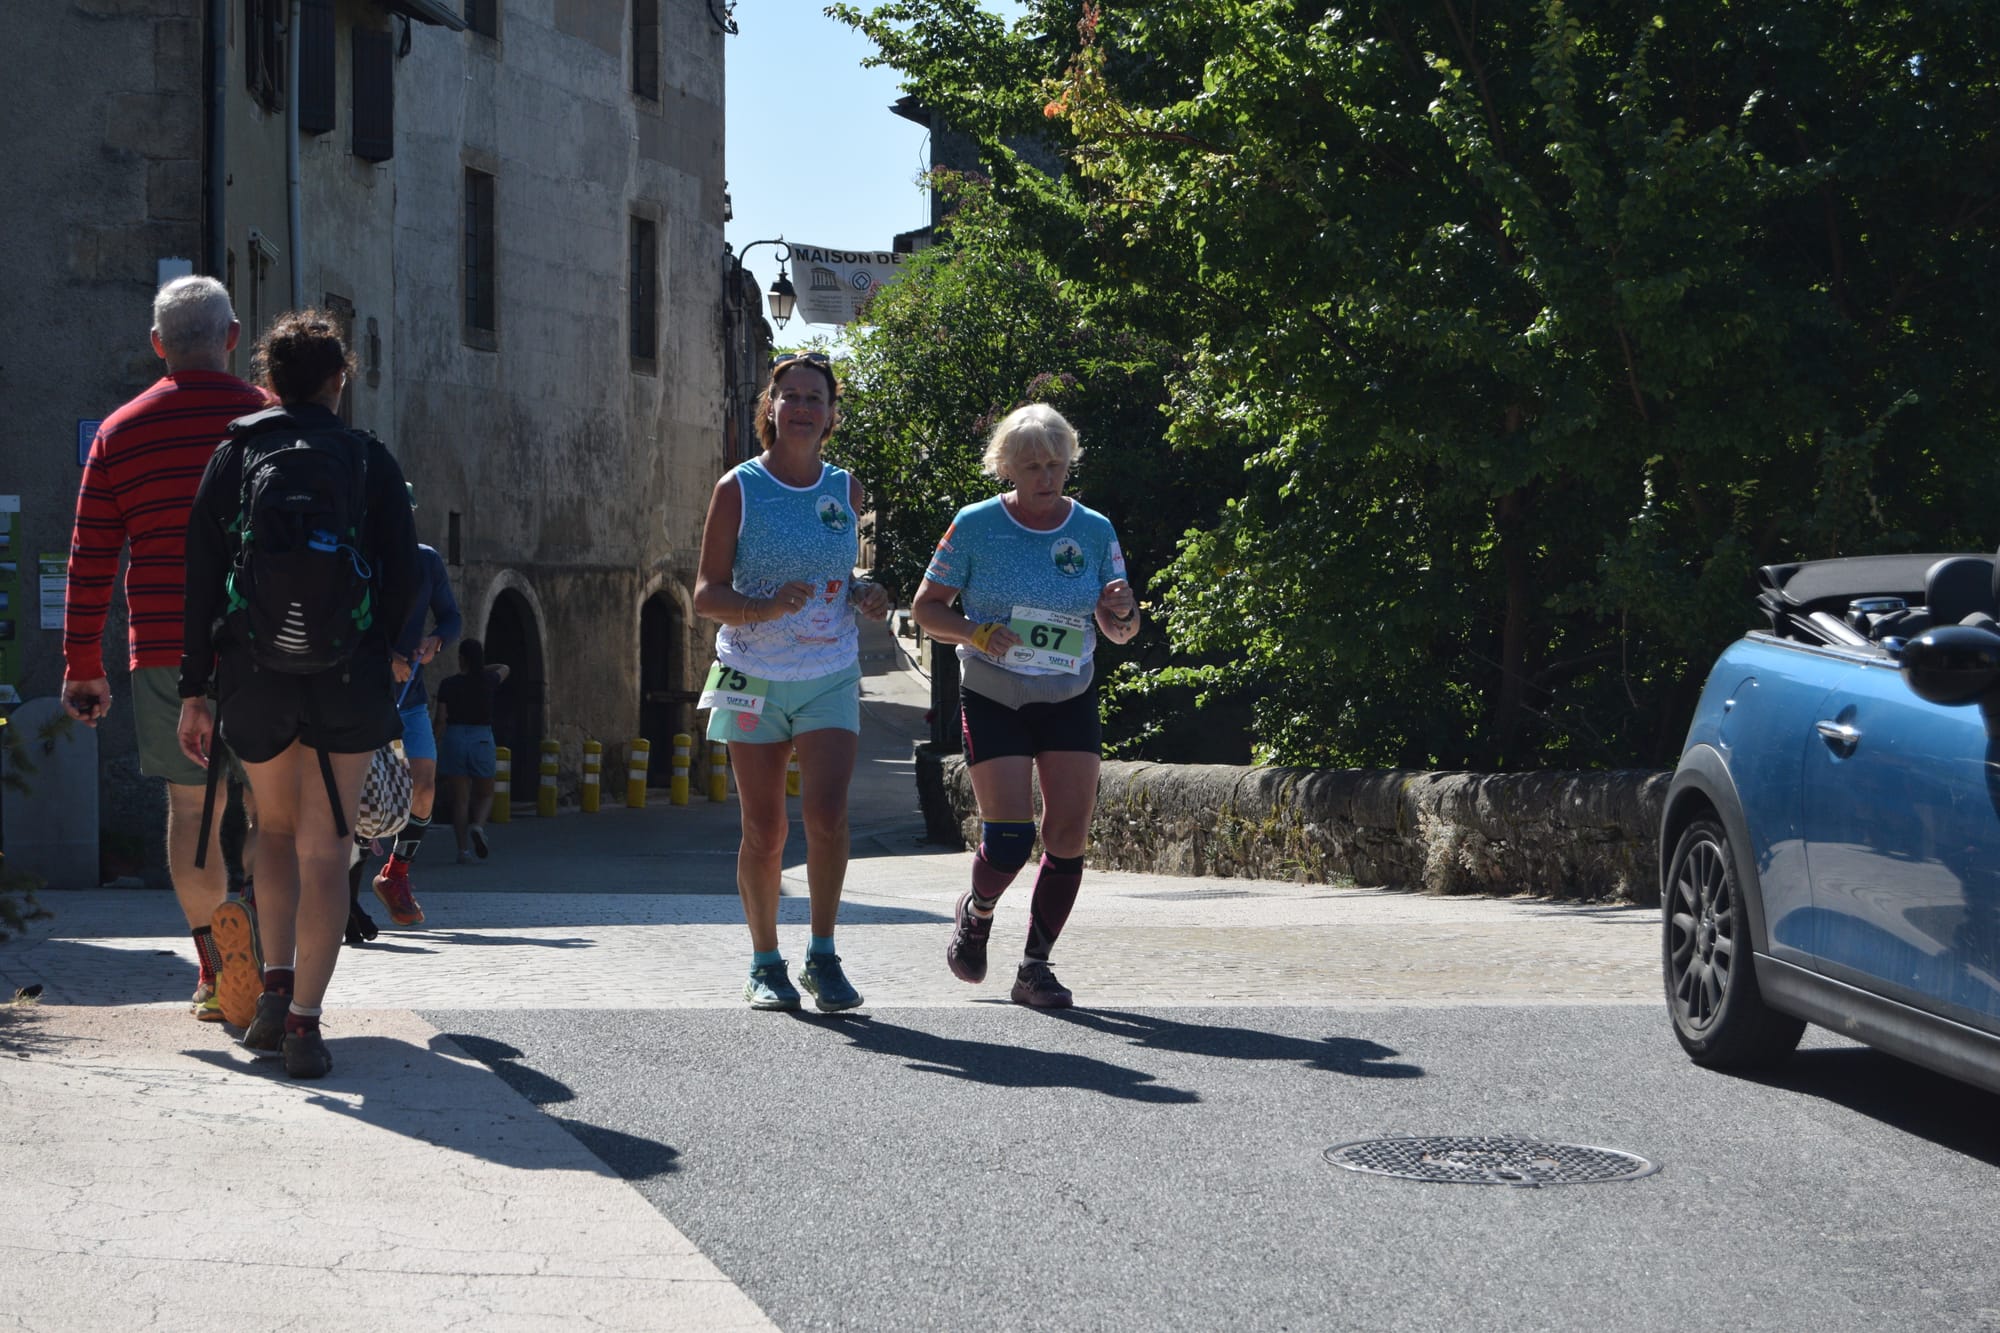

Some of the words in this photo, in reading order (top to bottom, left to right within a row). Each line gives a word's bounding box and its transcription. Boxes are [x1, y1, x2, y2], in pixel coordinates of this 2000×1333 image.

[795, 249, 872, 264] MAISON
[876, 253, 902, 264] DE
[1030, 624, 1068, 650] 67
[716, 666, 748, 691] 75
